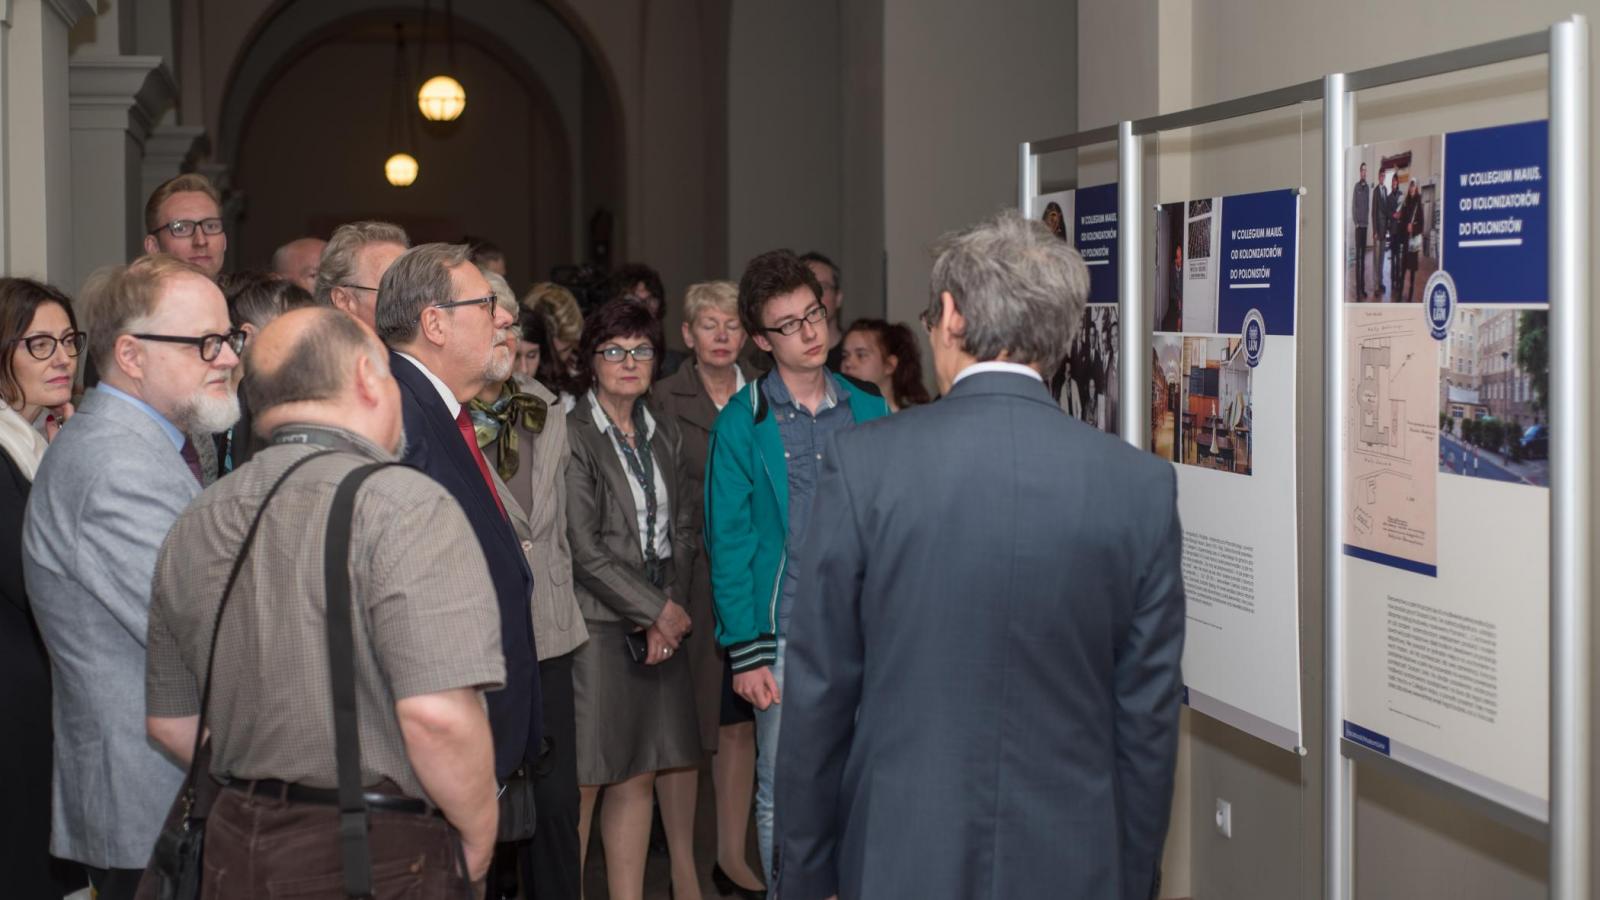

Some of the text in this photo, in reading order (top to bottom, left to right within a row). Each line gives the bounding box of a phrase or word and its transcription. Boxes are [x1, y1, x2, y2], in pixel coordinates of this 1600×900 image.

[1460, 166, 1542, 186] W COLLEGIUM MAIUS.
[1460, 190, 1540, 211] OD KOLONIZATORÓW
[1231, 226, 1283, 240] W COLLEGIUM MAIUS.
[1459, 217, 1522, 236] DO POLONISTÓW
[1230, 244, 1282, 259] OD KOLONIZATORÓW
[1230, 265, 1270, 279] DO POLONISTÓW
